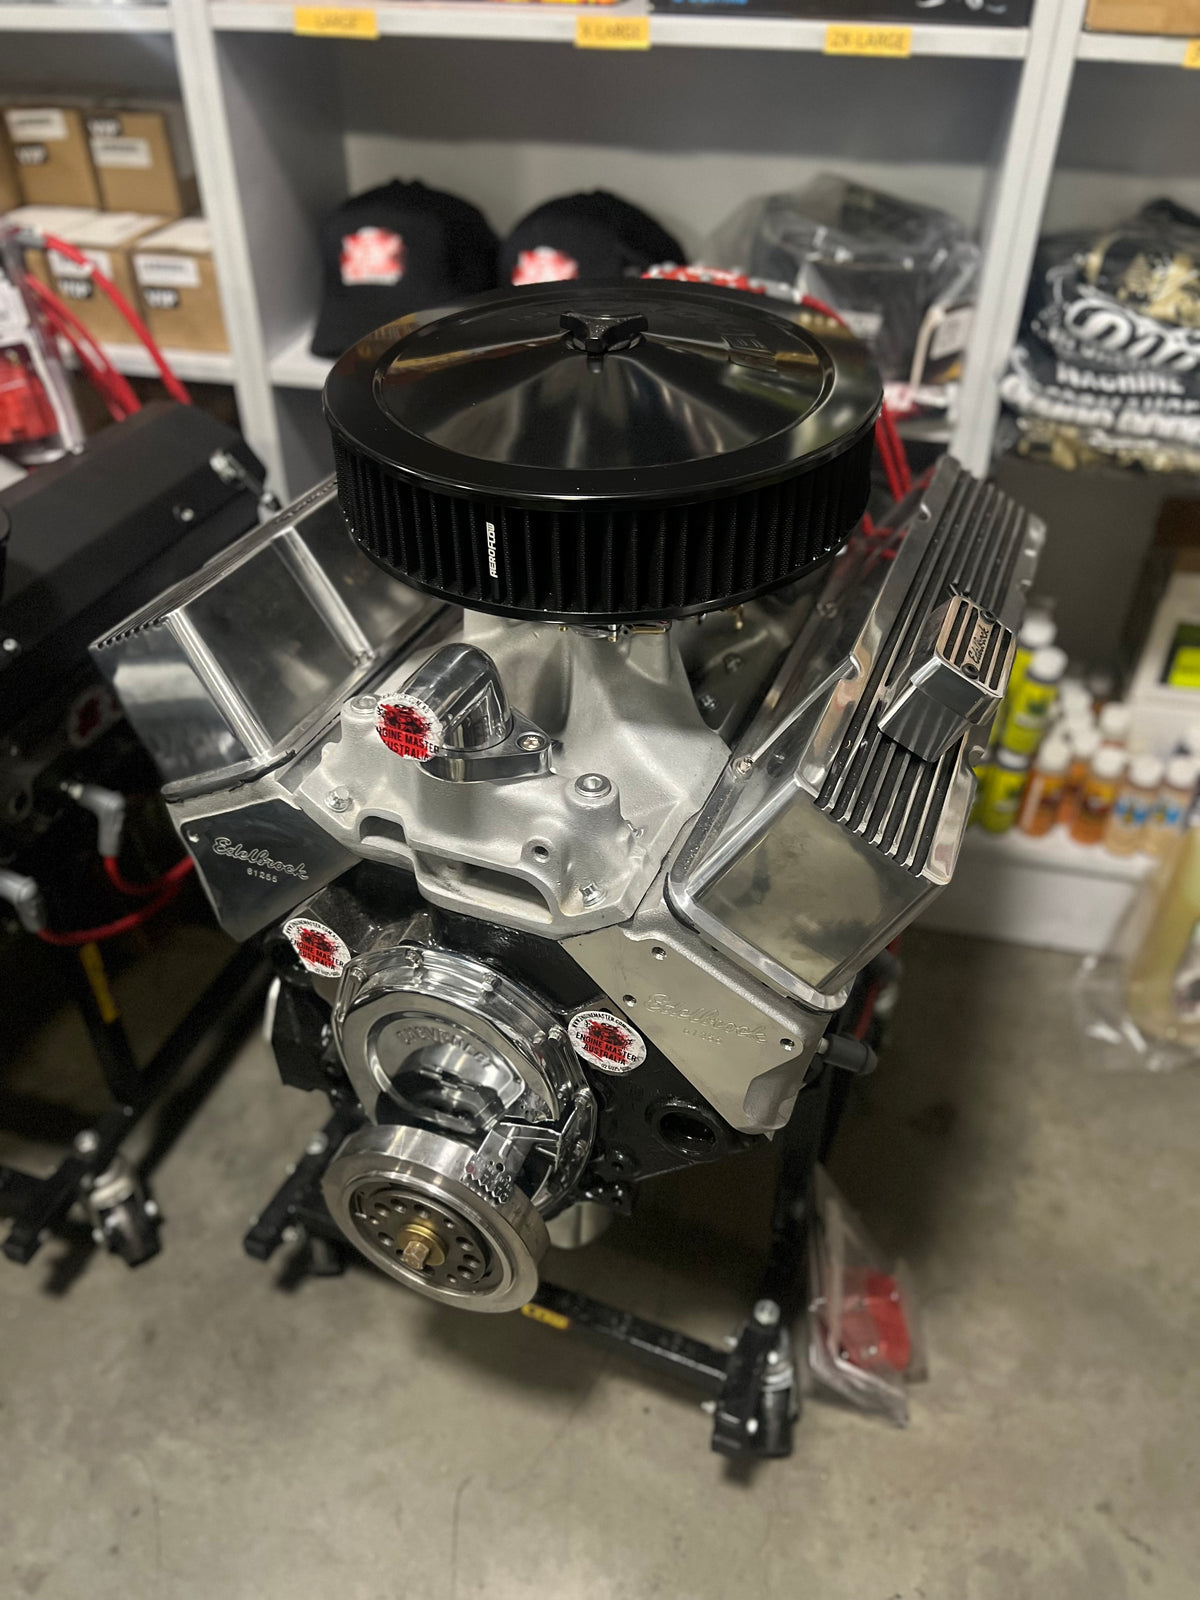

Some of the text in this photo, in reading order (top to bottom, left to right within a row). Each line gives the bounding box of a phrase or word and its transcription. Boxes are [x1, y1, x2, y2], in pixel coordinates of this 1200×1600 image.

[856, 31, 905, 50] LARGE
[485, 521, 499, 579] AEROFLOW
[375, 726, 440, 754] NGINE MASTER
[386, 740, 429, 761] USTRALIA
[212, 836, 310, 881] Edelbrock
[316, 948, 344, 967] MASTER
[643, 992, 767, 1044] Edelbrock
[575, 1031, 638, 1063] ENGINE MASTER
[583, 1043, 626, 1066] AUSTRALIA
